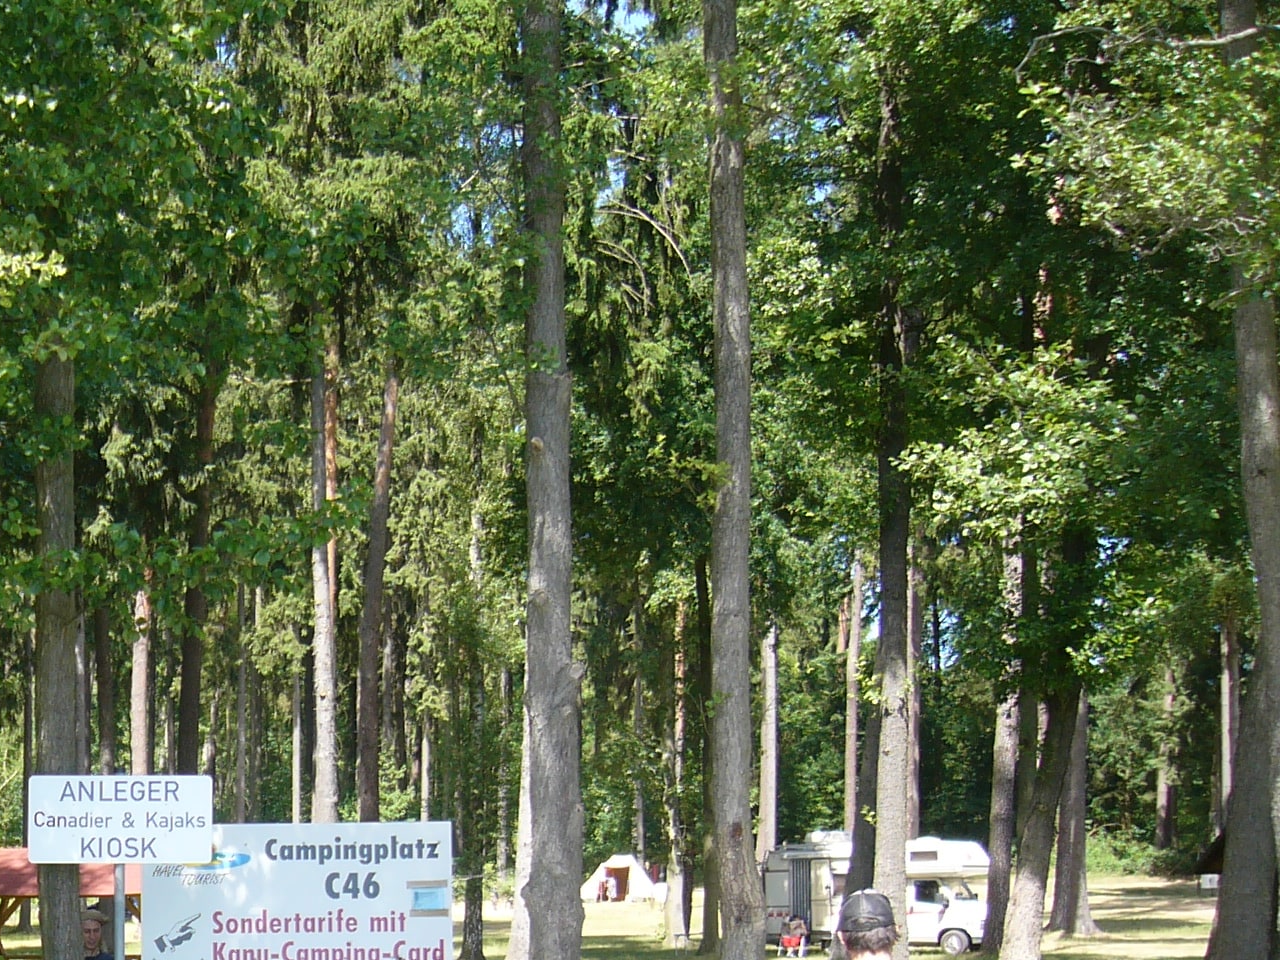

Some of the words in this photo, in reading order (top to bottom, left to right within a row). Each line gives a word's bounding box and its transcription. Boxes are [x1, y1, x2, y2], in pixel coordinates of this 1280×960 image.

[60, 780, 180, 802] ANLEGER
[33, 811, 112, 829] Canadier
[122, 811, 136, 829] &
[146, 811, 206, 832] Kajaks
[80, 837, 157, 859] KIOSK
[265, 836, 440, 865] Campingplatz
[182, 873, 230, 886] TOURIST
[325, 872, 380, 899] C46
[212, 909, 358, 934] Sondertarife
[369, 911, 406, 933] mit
